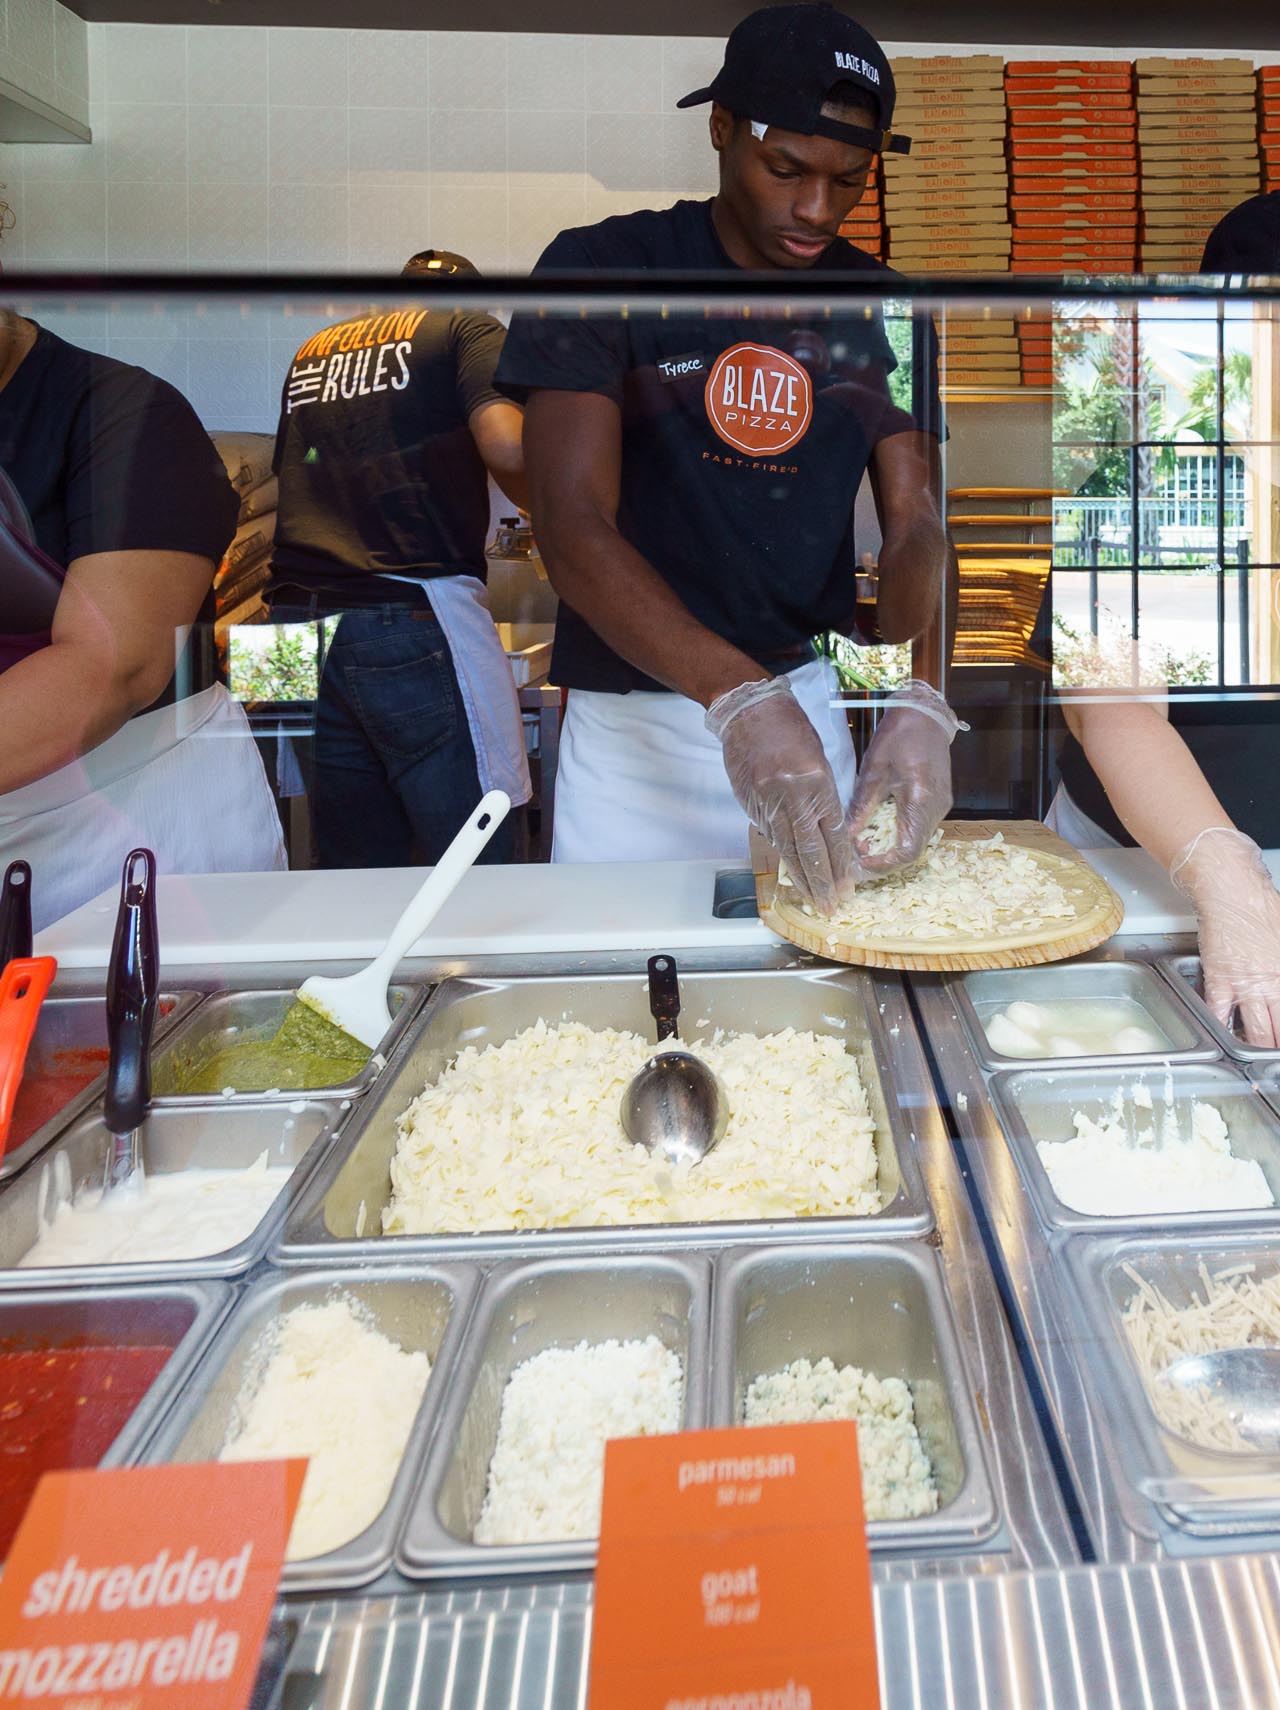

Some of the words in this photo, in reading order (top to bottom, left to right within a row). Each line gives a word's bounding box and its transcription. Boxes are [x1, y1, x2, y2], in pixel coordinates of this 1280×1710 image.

[835, 51, 861, 74] BLAZE
[861, 59, 880, 85] PIZZA
[296, 310, 429, 361] UNFOLLOW
[286, 359, 327, 414] THE
[321, 341, 412, 403] RULES
[722, 365, 799, 417] BLAZE
[725, 412, 792, 432] PIZZA
[678, 1452, 796, 1491] parmesan
[22, 1540, 254, 1620] shredded
[700, 1565, 757, 1606] goat
[0, 1617, 240, 1700] mozzarella
